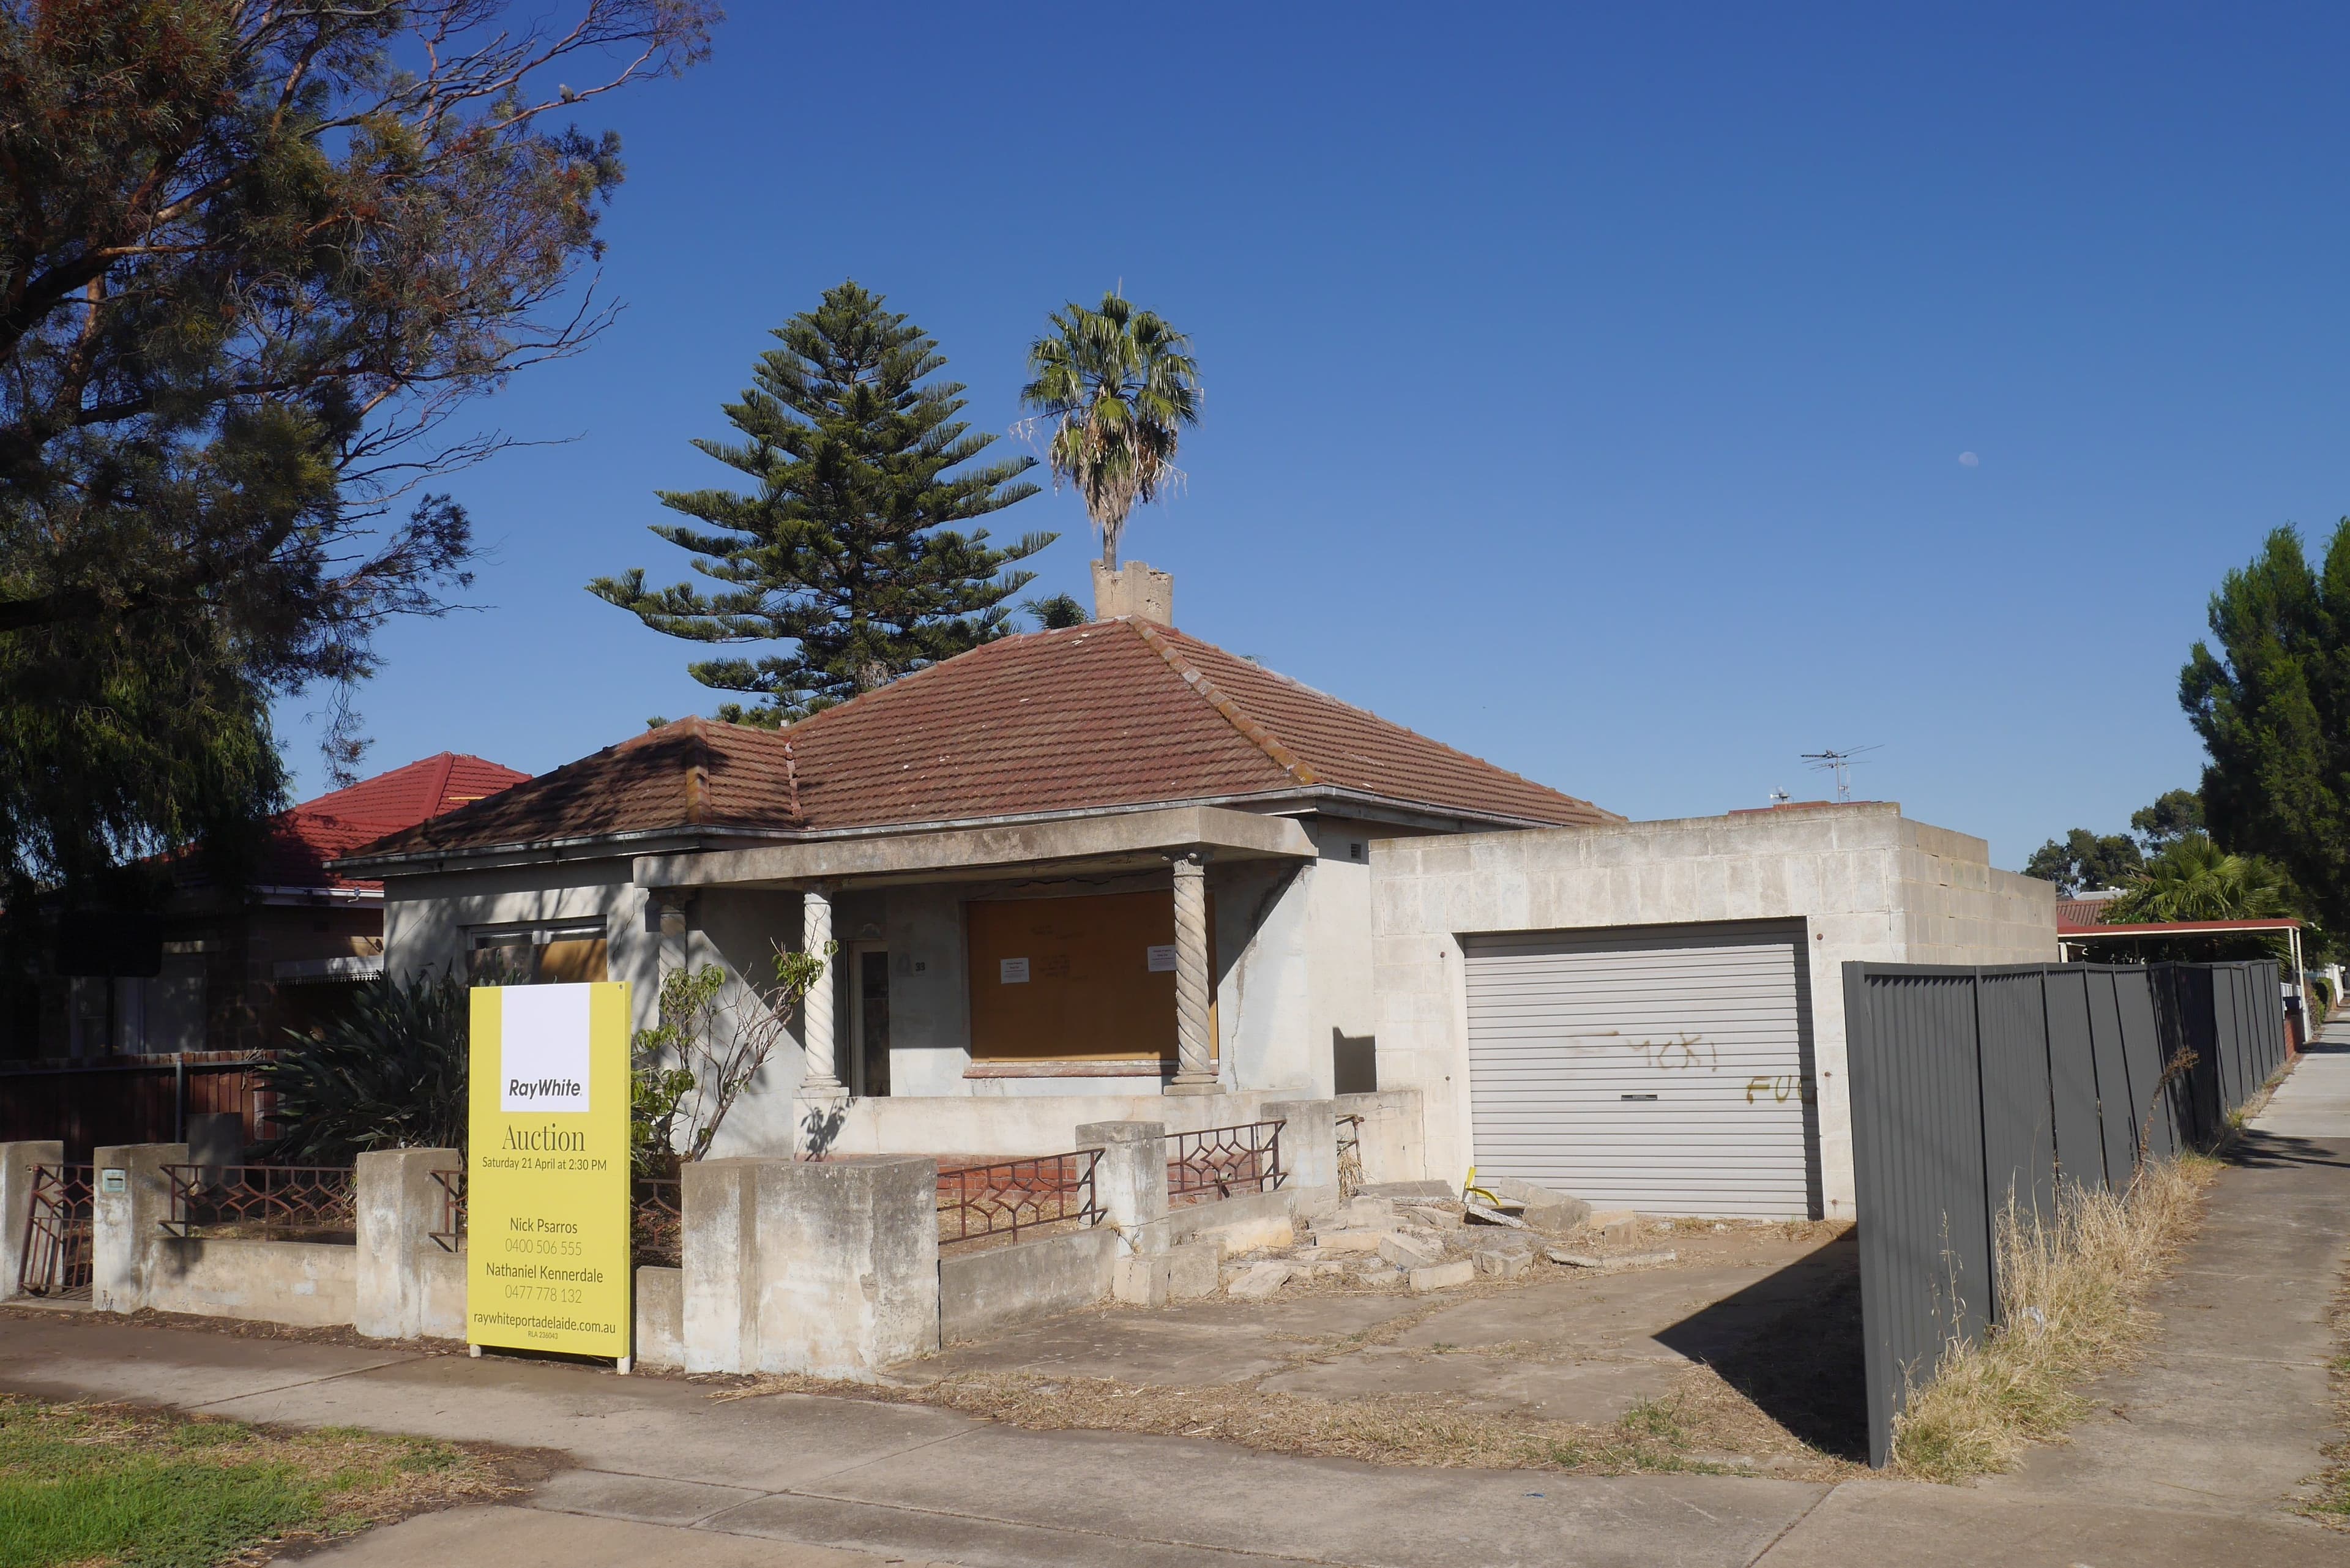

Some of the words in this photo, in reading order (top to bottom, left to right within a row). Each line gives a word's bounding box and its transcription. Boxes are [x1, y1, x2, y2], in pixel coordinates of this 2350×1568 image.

[915, 962, 925, 971] 33
[509, 1079, 581, 1100] RayWhite
[502, 1123, 586, 1151] Auction
[482, 1157, 519, 1170] Saturday
[521, 1157, 532, 1168] 21
[534, 1158, 555, 1171] April
[558, 1160, 566, 1170] at
[569, 1159, 588, 1170] 2:30
[592, 1160, 606, 1170] PM
[510, 1217, 534, 1232] Nick
[537, 1219, 577, 1234] Psarros
[505, 1238, 533, 1253] 0400
[536, 1240, 557, 1254] 506
[561, 1241, 582, 1255] 555
[487, 1262, 536, 1279] Nathaniel
[540, 1266, 603, 1283] Kennerdale
[505, 1285, 532, 1299] 0477
[536, 1286, 557, 1302] 778
[561, 1288, 582, 1303] 132
[474, 1312, 616, 1334] raywhiteportadelaide.com.au
